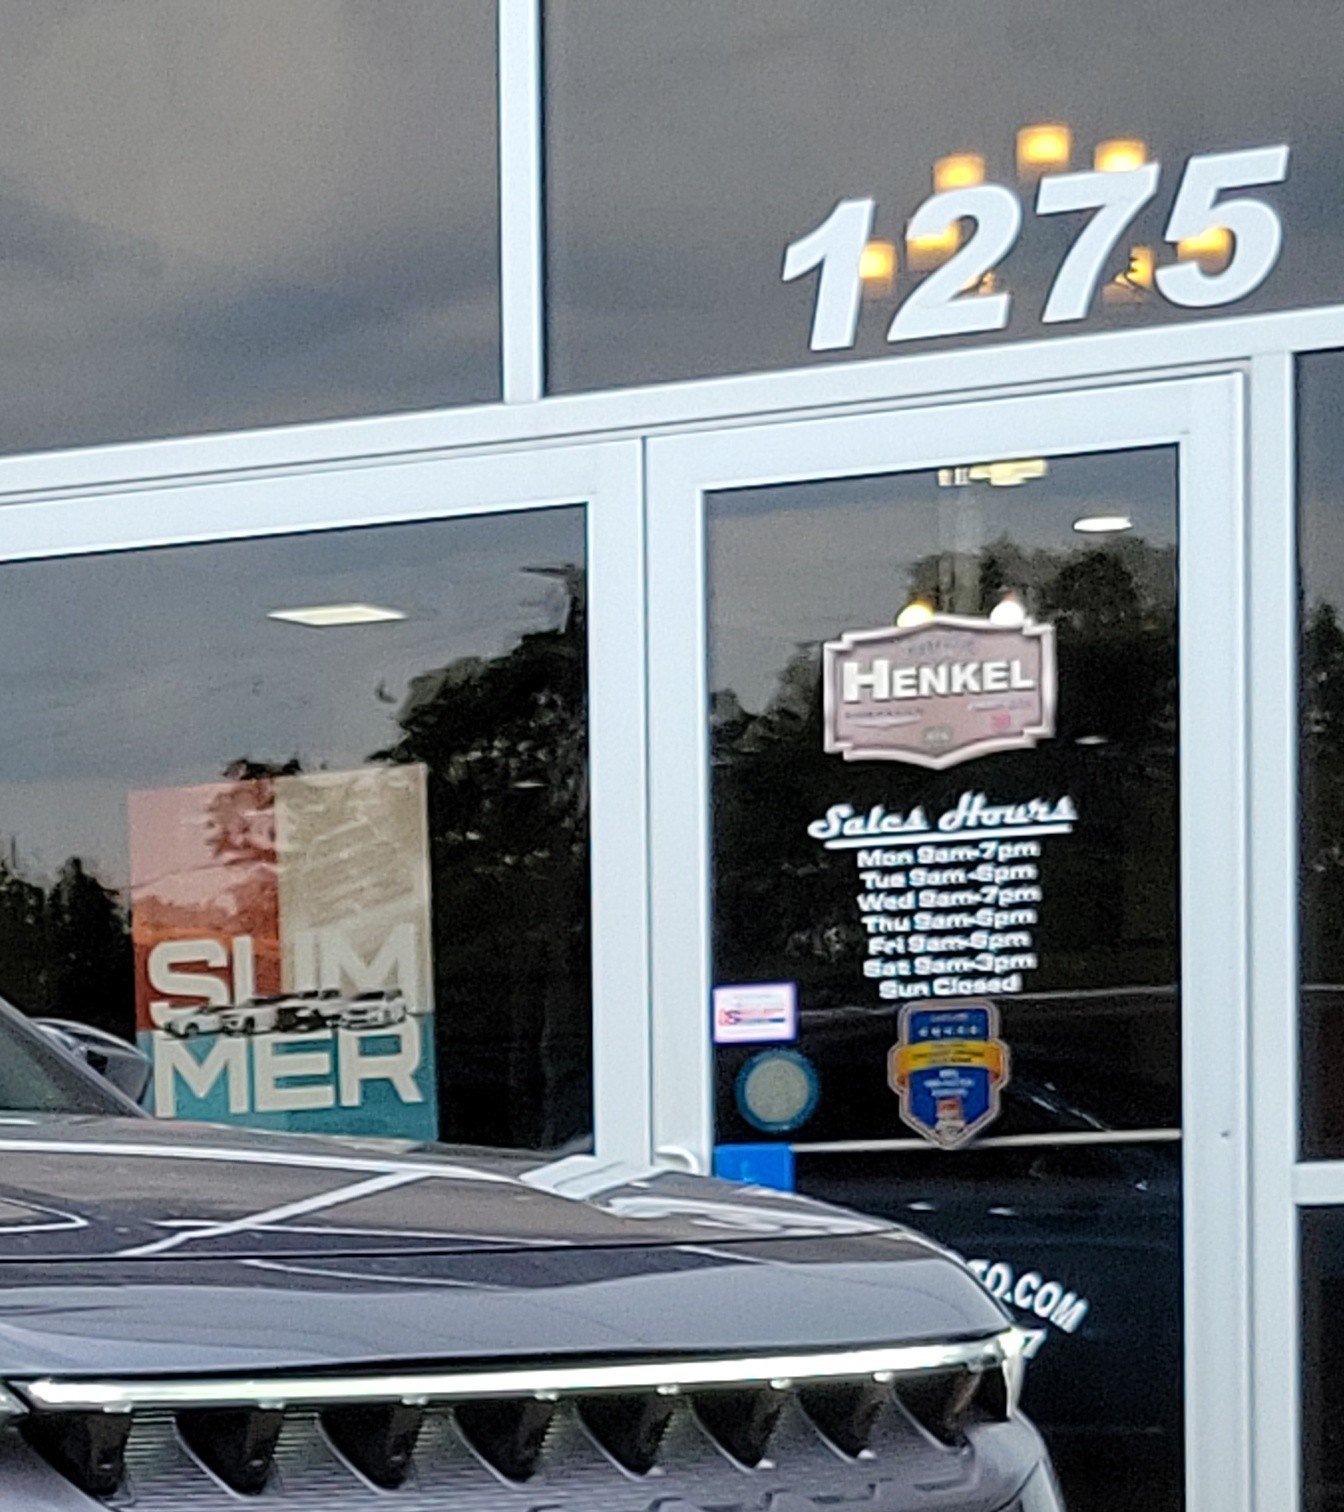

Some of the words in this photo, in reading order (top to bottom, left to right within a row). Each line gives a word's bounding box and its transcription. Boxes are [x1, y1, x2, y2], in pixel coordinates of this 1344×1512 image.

[782, 145, 1289, 351] 1275
[843, 659, 1035, 701] HENKEL
[807, 803, 930, 838] Sales
[938, 790, 1078, 831] Hours
[857, 850, 913, 868] Mon
[917, 841, 1041, 864] 9am-7pm
[859, 871, 907, 890] Tue
[857, 891, 916, 911] Wed
[918, 885, 1043, 907] 9am-7pm
[862, 915, 911, 933] Thu
[868, 936, 905, 955] Fri
[863, 958, 911, 977] Sat
[879, 980, 930, 999] Sun
[933, 973, 1023, 995] Closed
[154, 1018, 423, 1119] MER
